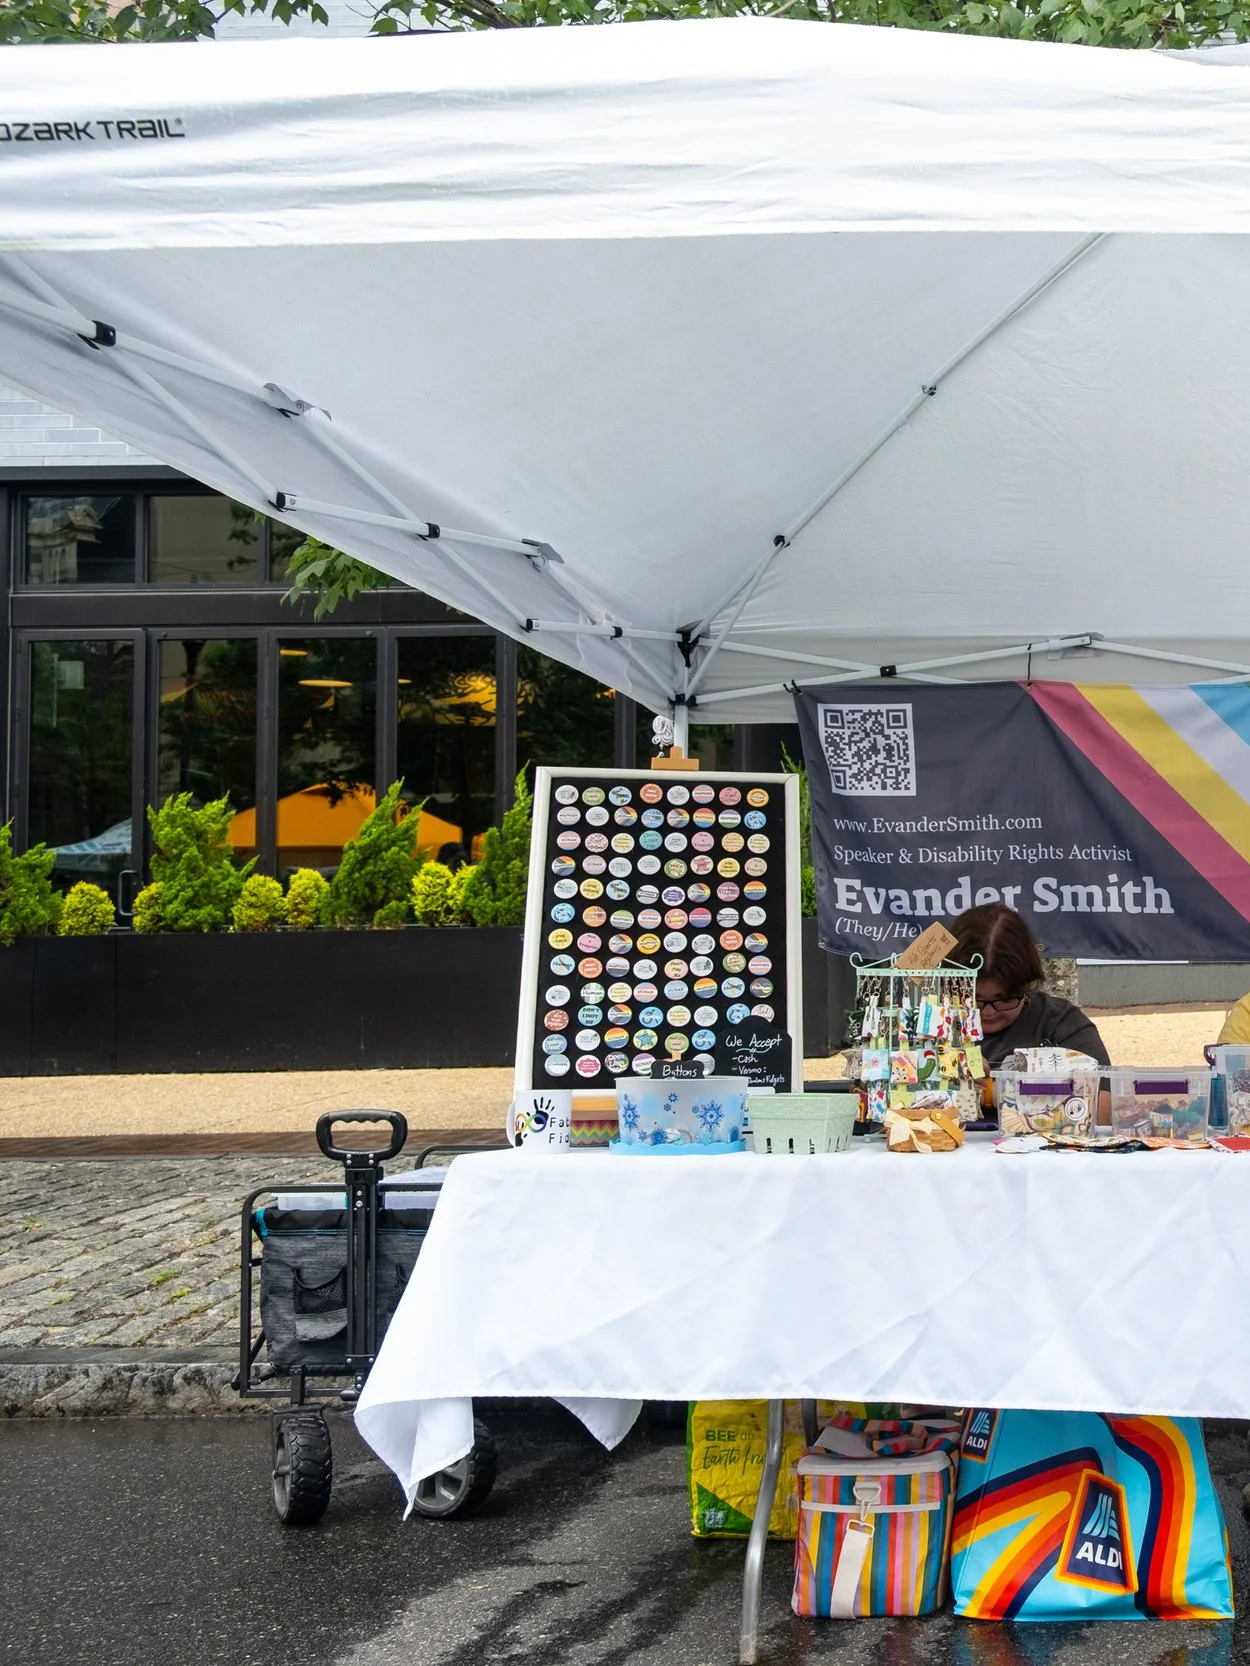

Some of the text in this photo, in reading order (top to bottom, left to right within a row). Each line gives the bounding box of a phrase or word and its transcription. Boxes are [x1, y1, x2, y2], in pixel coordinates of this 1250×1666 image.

[833, 815, 1042, 834] www.EvanderSmith.com
[833, 843, 1133, 865] Speaker & Disability Rights Activist
[833, 873, 1175, 916] Evander Smith
[835, 917, 923, 941] (They/He)
[725, 1033, 783, 1048] We Accept
[662, 1064, 698, 1077] Buttons
[705, 1429, 736, 1442] BEE
[966, 1435, 987, 1450] ALDI
[1075, 1541, 1123, 1570] ALDI
